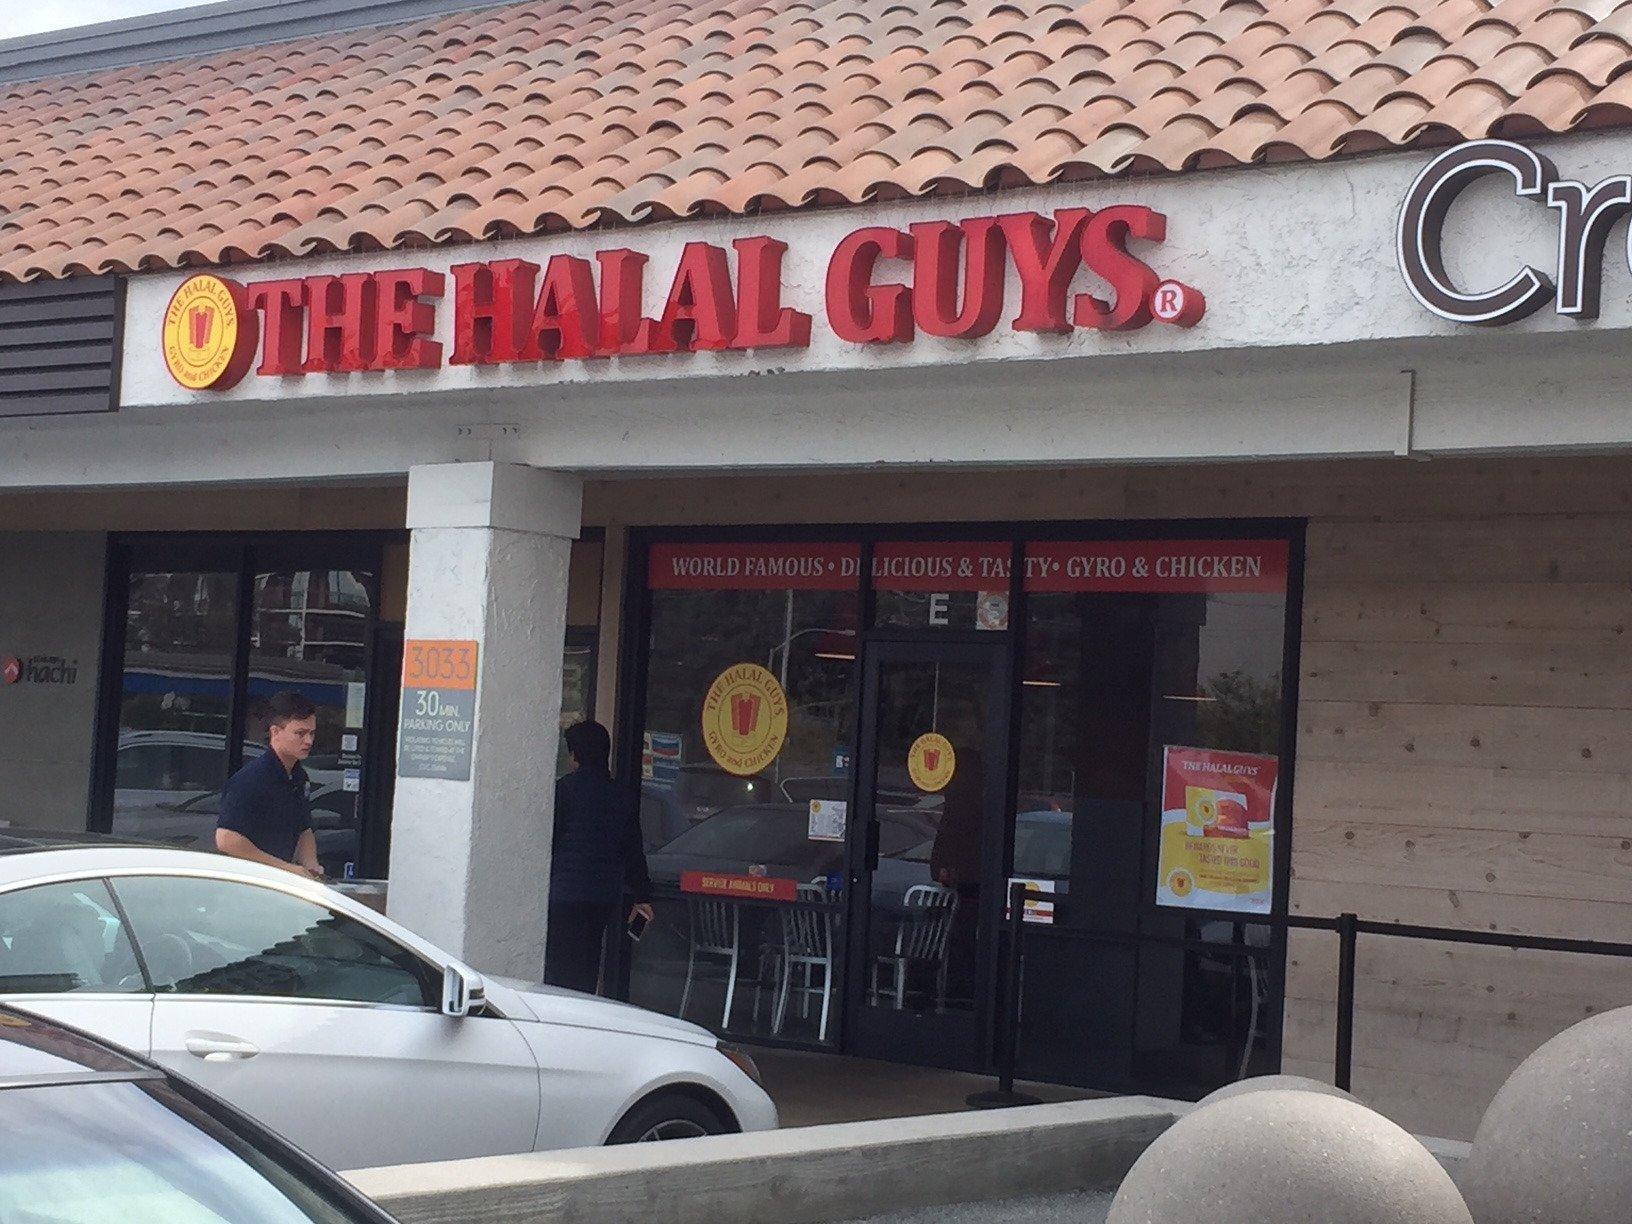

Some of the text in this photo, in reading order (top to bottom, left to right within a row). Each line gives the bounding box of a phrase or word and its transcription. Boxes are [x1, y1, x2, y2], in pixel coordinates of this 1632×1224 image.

[1396, 139, 1632, 327] Cr
[246, 267, 444, 377] THE
[449, 235, 812, 366] HALAL
[671, 556, 740, 577] WORLD
[745, 556, 824, 577] FAMOUS
[841, 556, 954, 578] DLICIOUS
[957, 557, 974, 578] &
[1066, 556, 1127, 578] GYRO
[1131, 556, 1149, 578] &
[1155, 555, 1263, 578] CHICKEN
[929, 593, 950, 625] E
[409, 645, 471, 679] 3033
[415, 690, 440, 717] 30
[707, 668, 785, 716] THE HALAL GUYS
[404, 718, 471, 732] PARKING ONLY
[1183, 761, 1259, 776] THE HALAL GUYS
